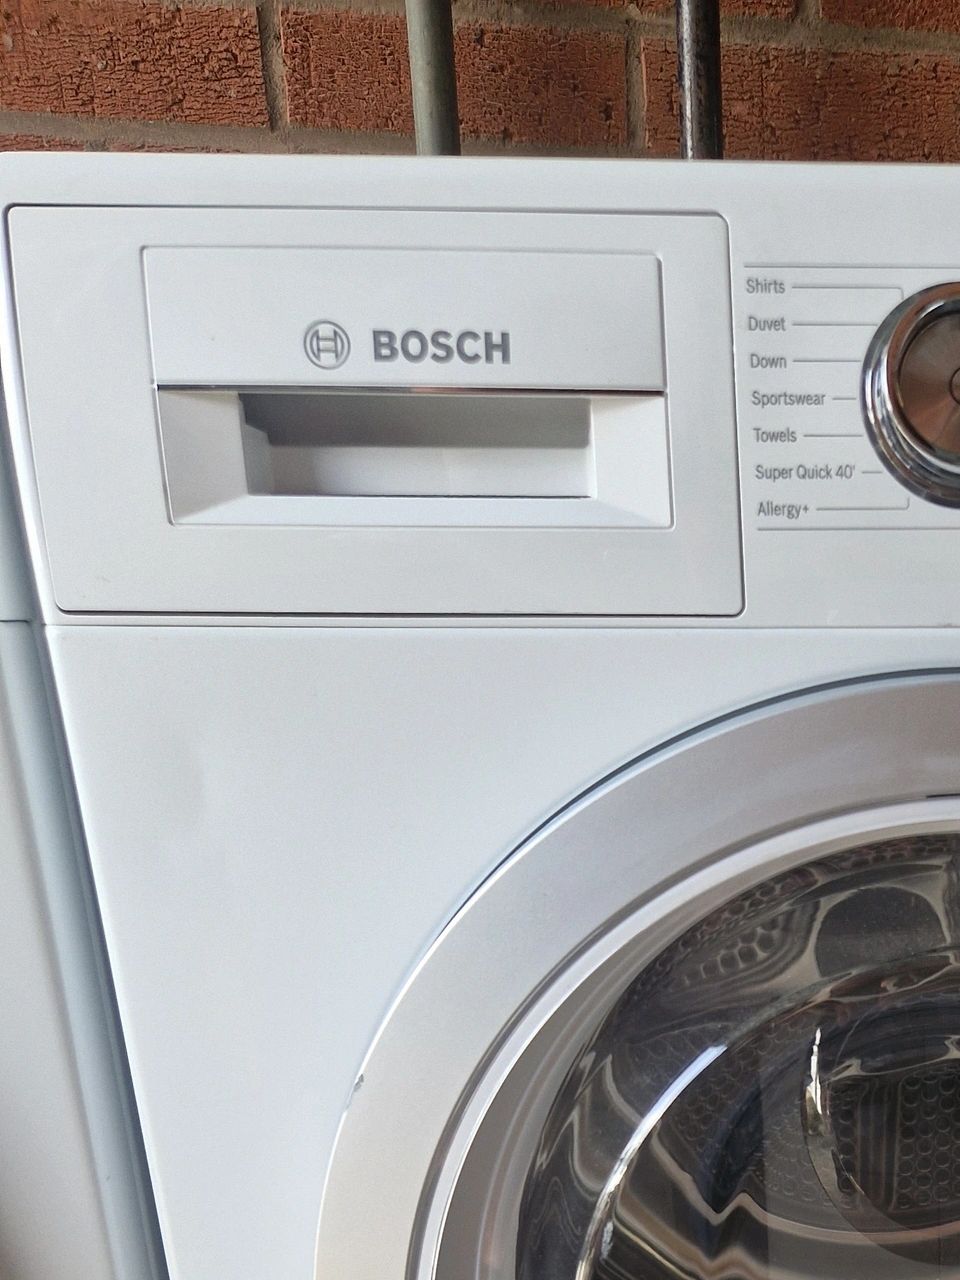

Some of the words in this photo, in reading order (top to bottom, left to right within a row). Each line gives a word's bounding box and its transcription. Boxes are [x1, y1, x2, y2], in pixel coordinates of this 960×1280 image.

[746, 278, 785, 294] Shirts
[748, 317, 786, 332] Duvet
[371, 329, 511, 364] BOSCH
[750, 354, 787, 369] Down
[751, 391, 826, 408] Sportswear
[753, 427, 797, 443] Towels
[755, 464, 793, 482] Super
[796, 464, 833, 480] Quick
[757, 501, 810, 519] Allergy+
